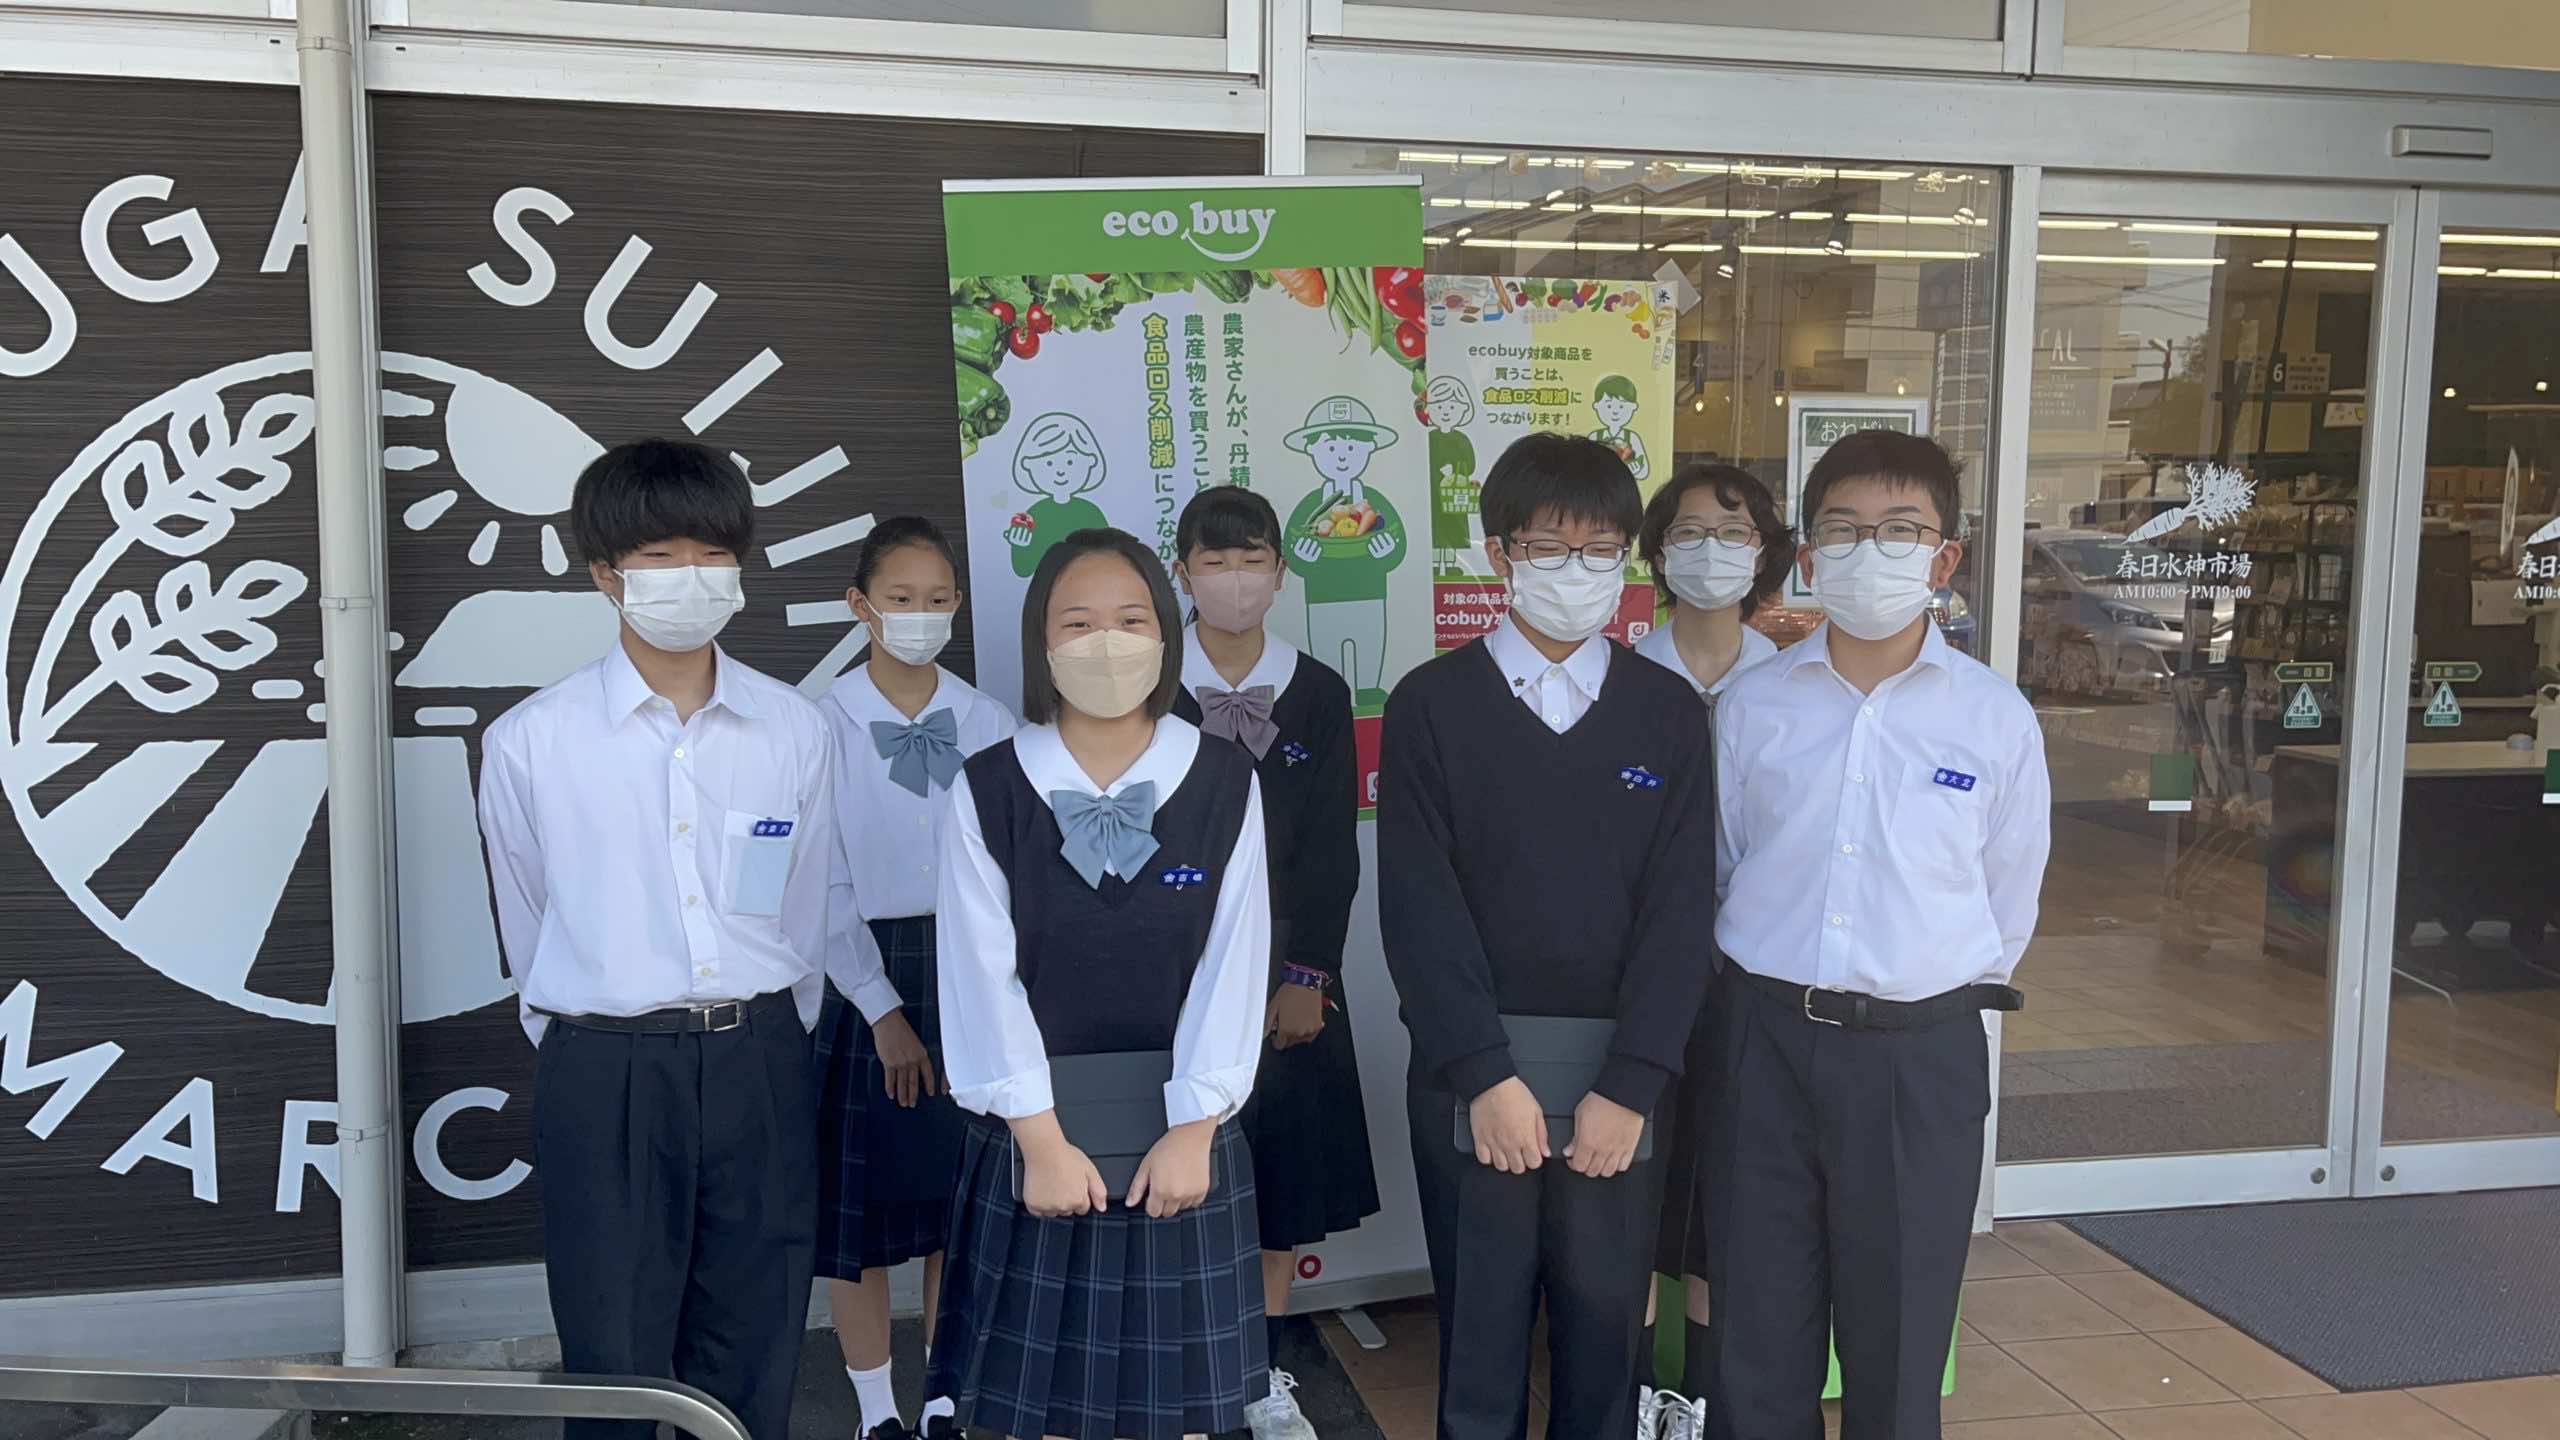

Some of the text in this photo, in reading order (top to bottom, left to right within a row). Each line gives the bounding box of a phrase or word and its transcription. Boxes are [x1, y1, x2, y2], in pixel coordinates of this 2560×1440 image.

[1103, 200, 1278, 262] eco buy
[1468, 343, 1593, 361] ecobuy対象商品を
[1494, 366, 1564, 381] 買うことは、
[1482, 386, 1583, 405] 食品ロス削減に
[2115, 550, 2254, 579] 春日水神市場
[2515, 551, 2560, 579] 春日
